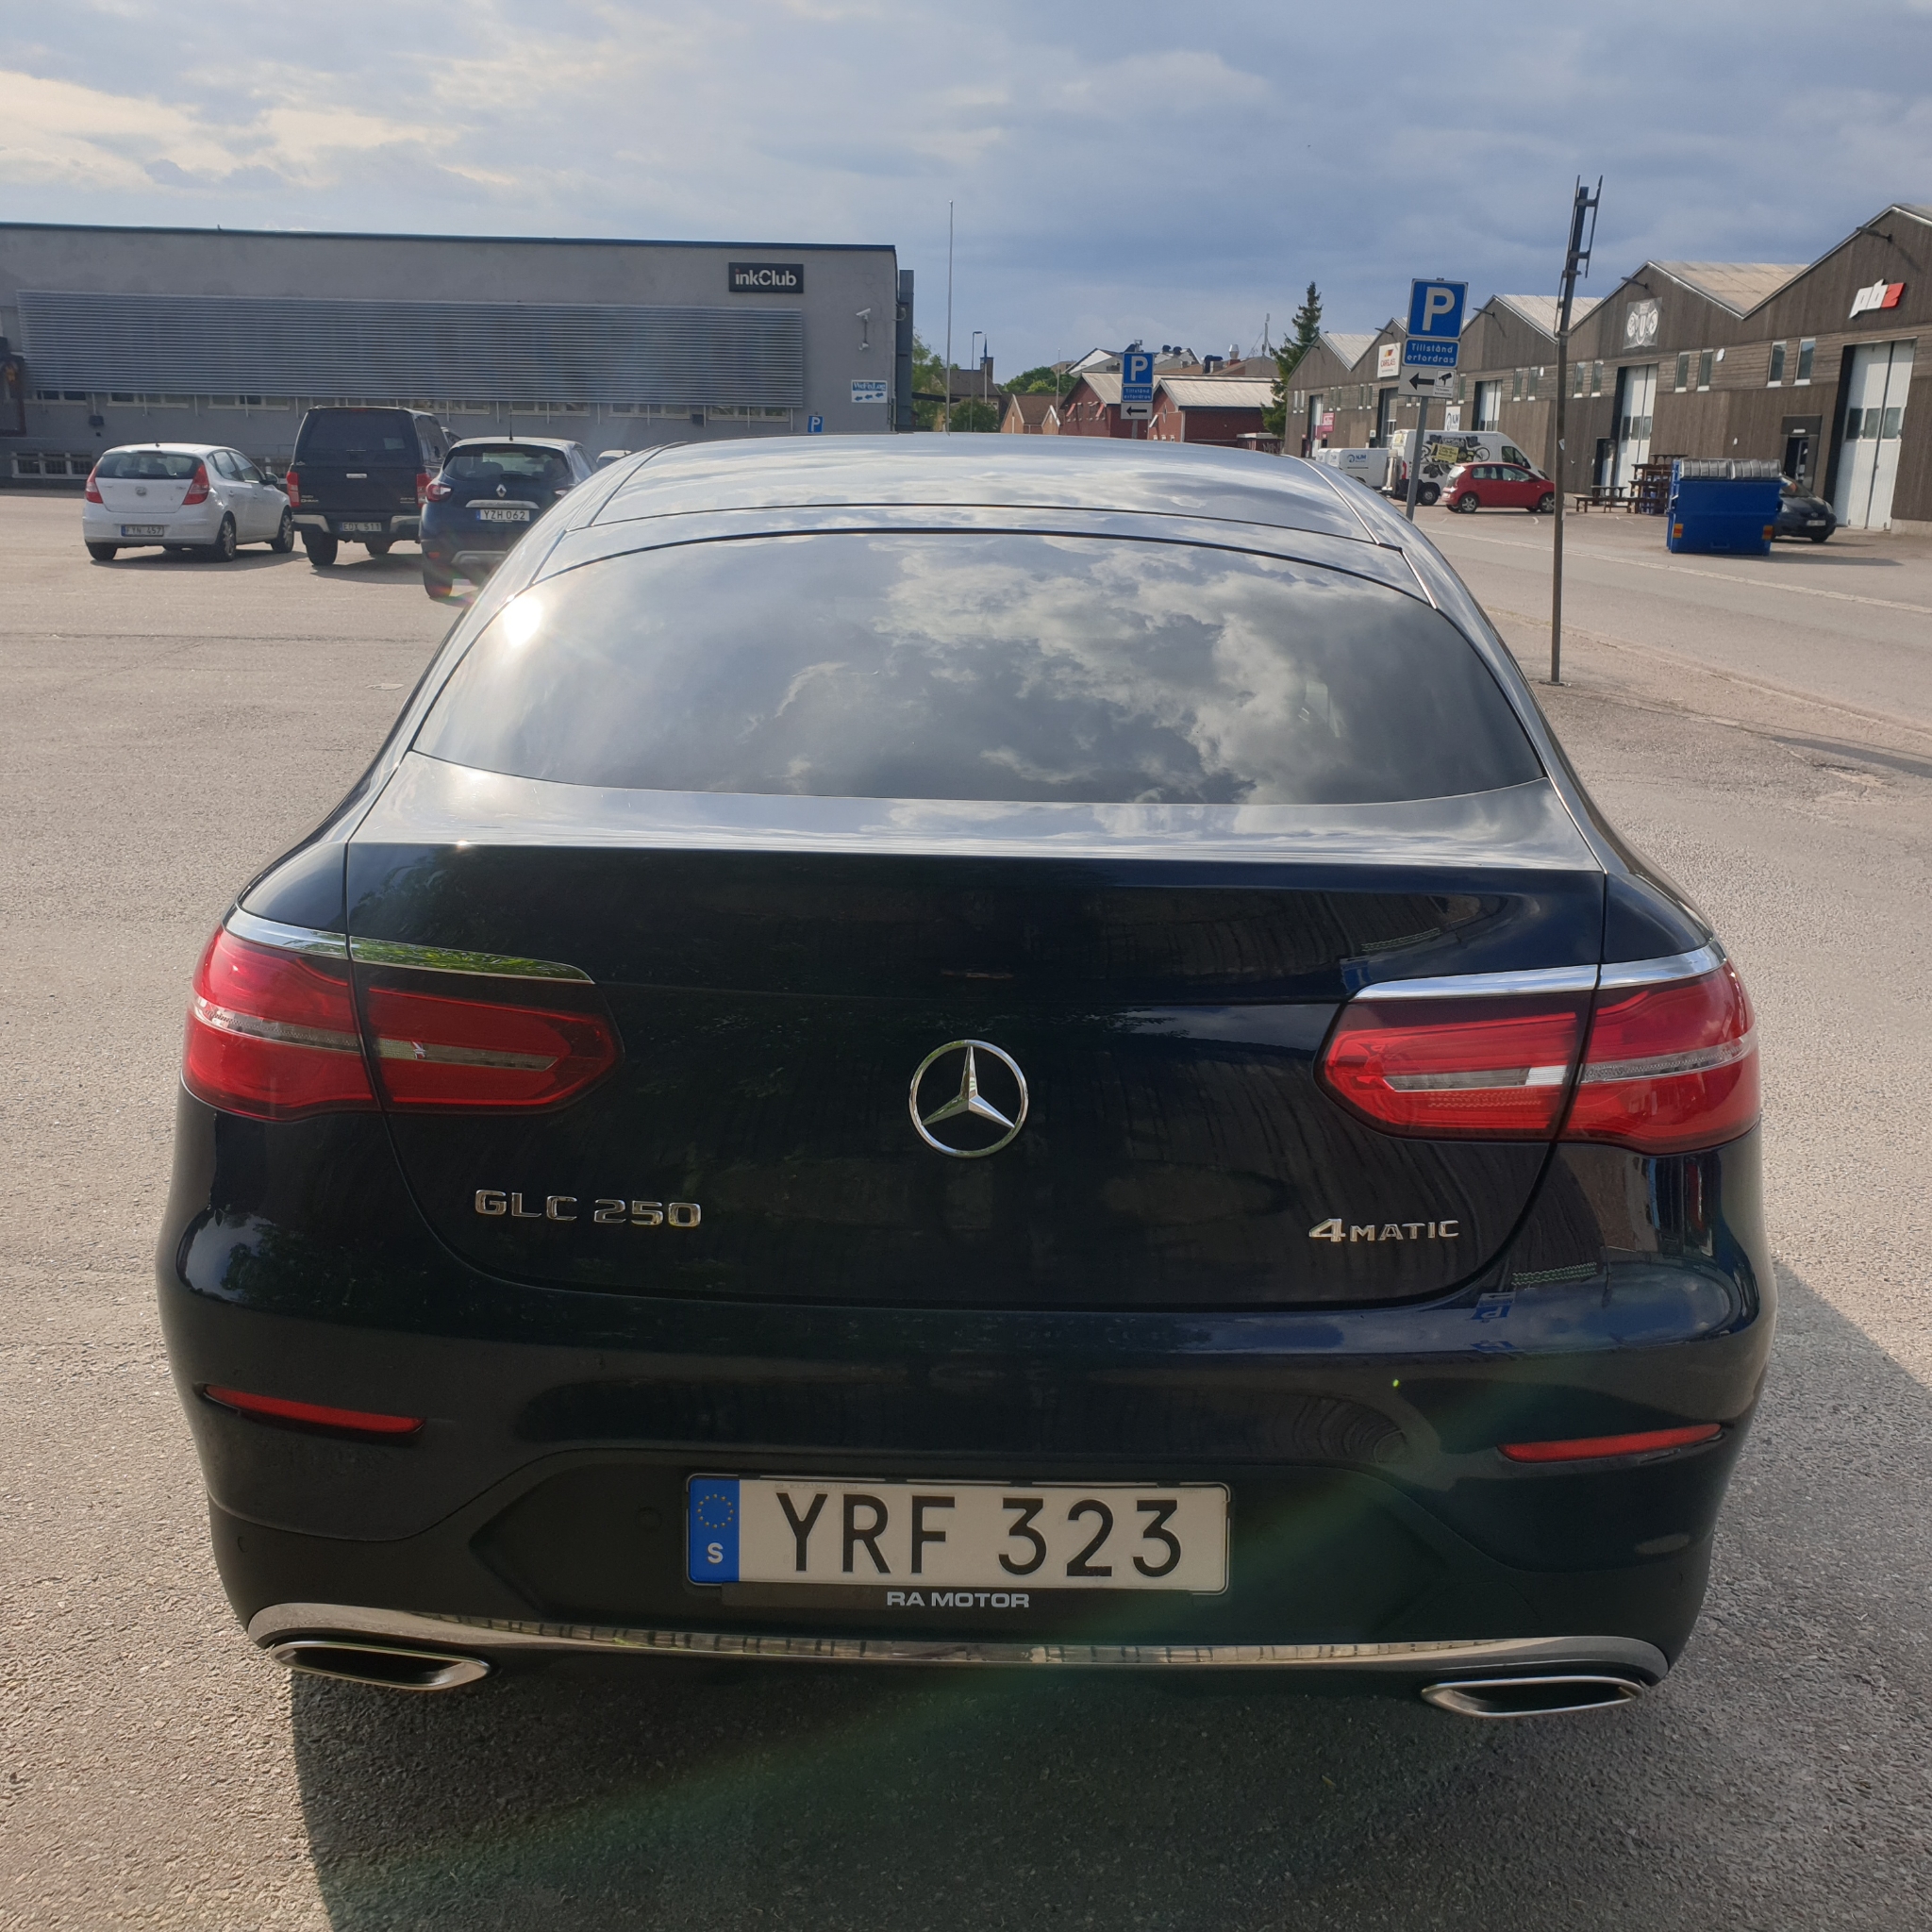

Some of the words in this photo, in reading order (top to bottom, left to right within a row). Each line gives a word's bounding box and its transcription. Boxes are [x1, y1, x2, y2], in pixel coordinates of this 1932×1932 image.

[735, 269, 797, 286] inkClub
[1422, 287, 1456, 331] P
[1411, 343, 1454, 354] Tillstånd
[1130, 356, 1148, 381] P
[1407, 354, 1455, 364] erfordras
[811, 417, 821, 431] P
[483, 510, 503, 520] YZH
[506, 510, 525, 520] 062
[475, 1189, 577, 1221] GLC
[593, 1199, 702, 1227] 250
[1308, 1218, 1459, 1242] 4MATIC
[775, 1492, 956, 1574] YRF
[998, 1497, 1182, 1578] 323
[708, 1542, 724, 1563] S
[887, 1591, 925, 1607] RA
[931, 1592, 1029, 1608] MOTOR
